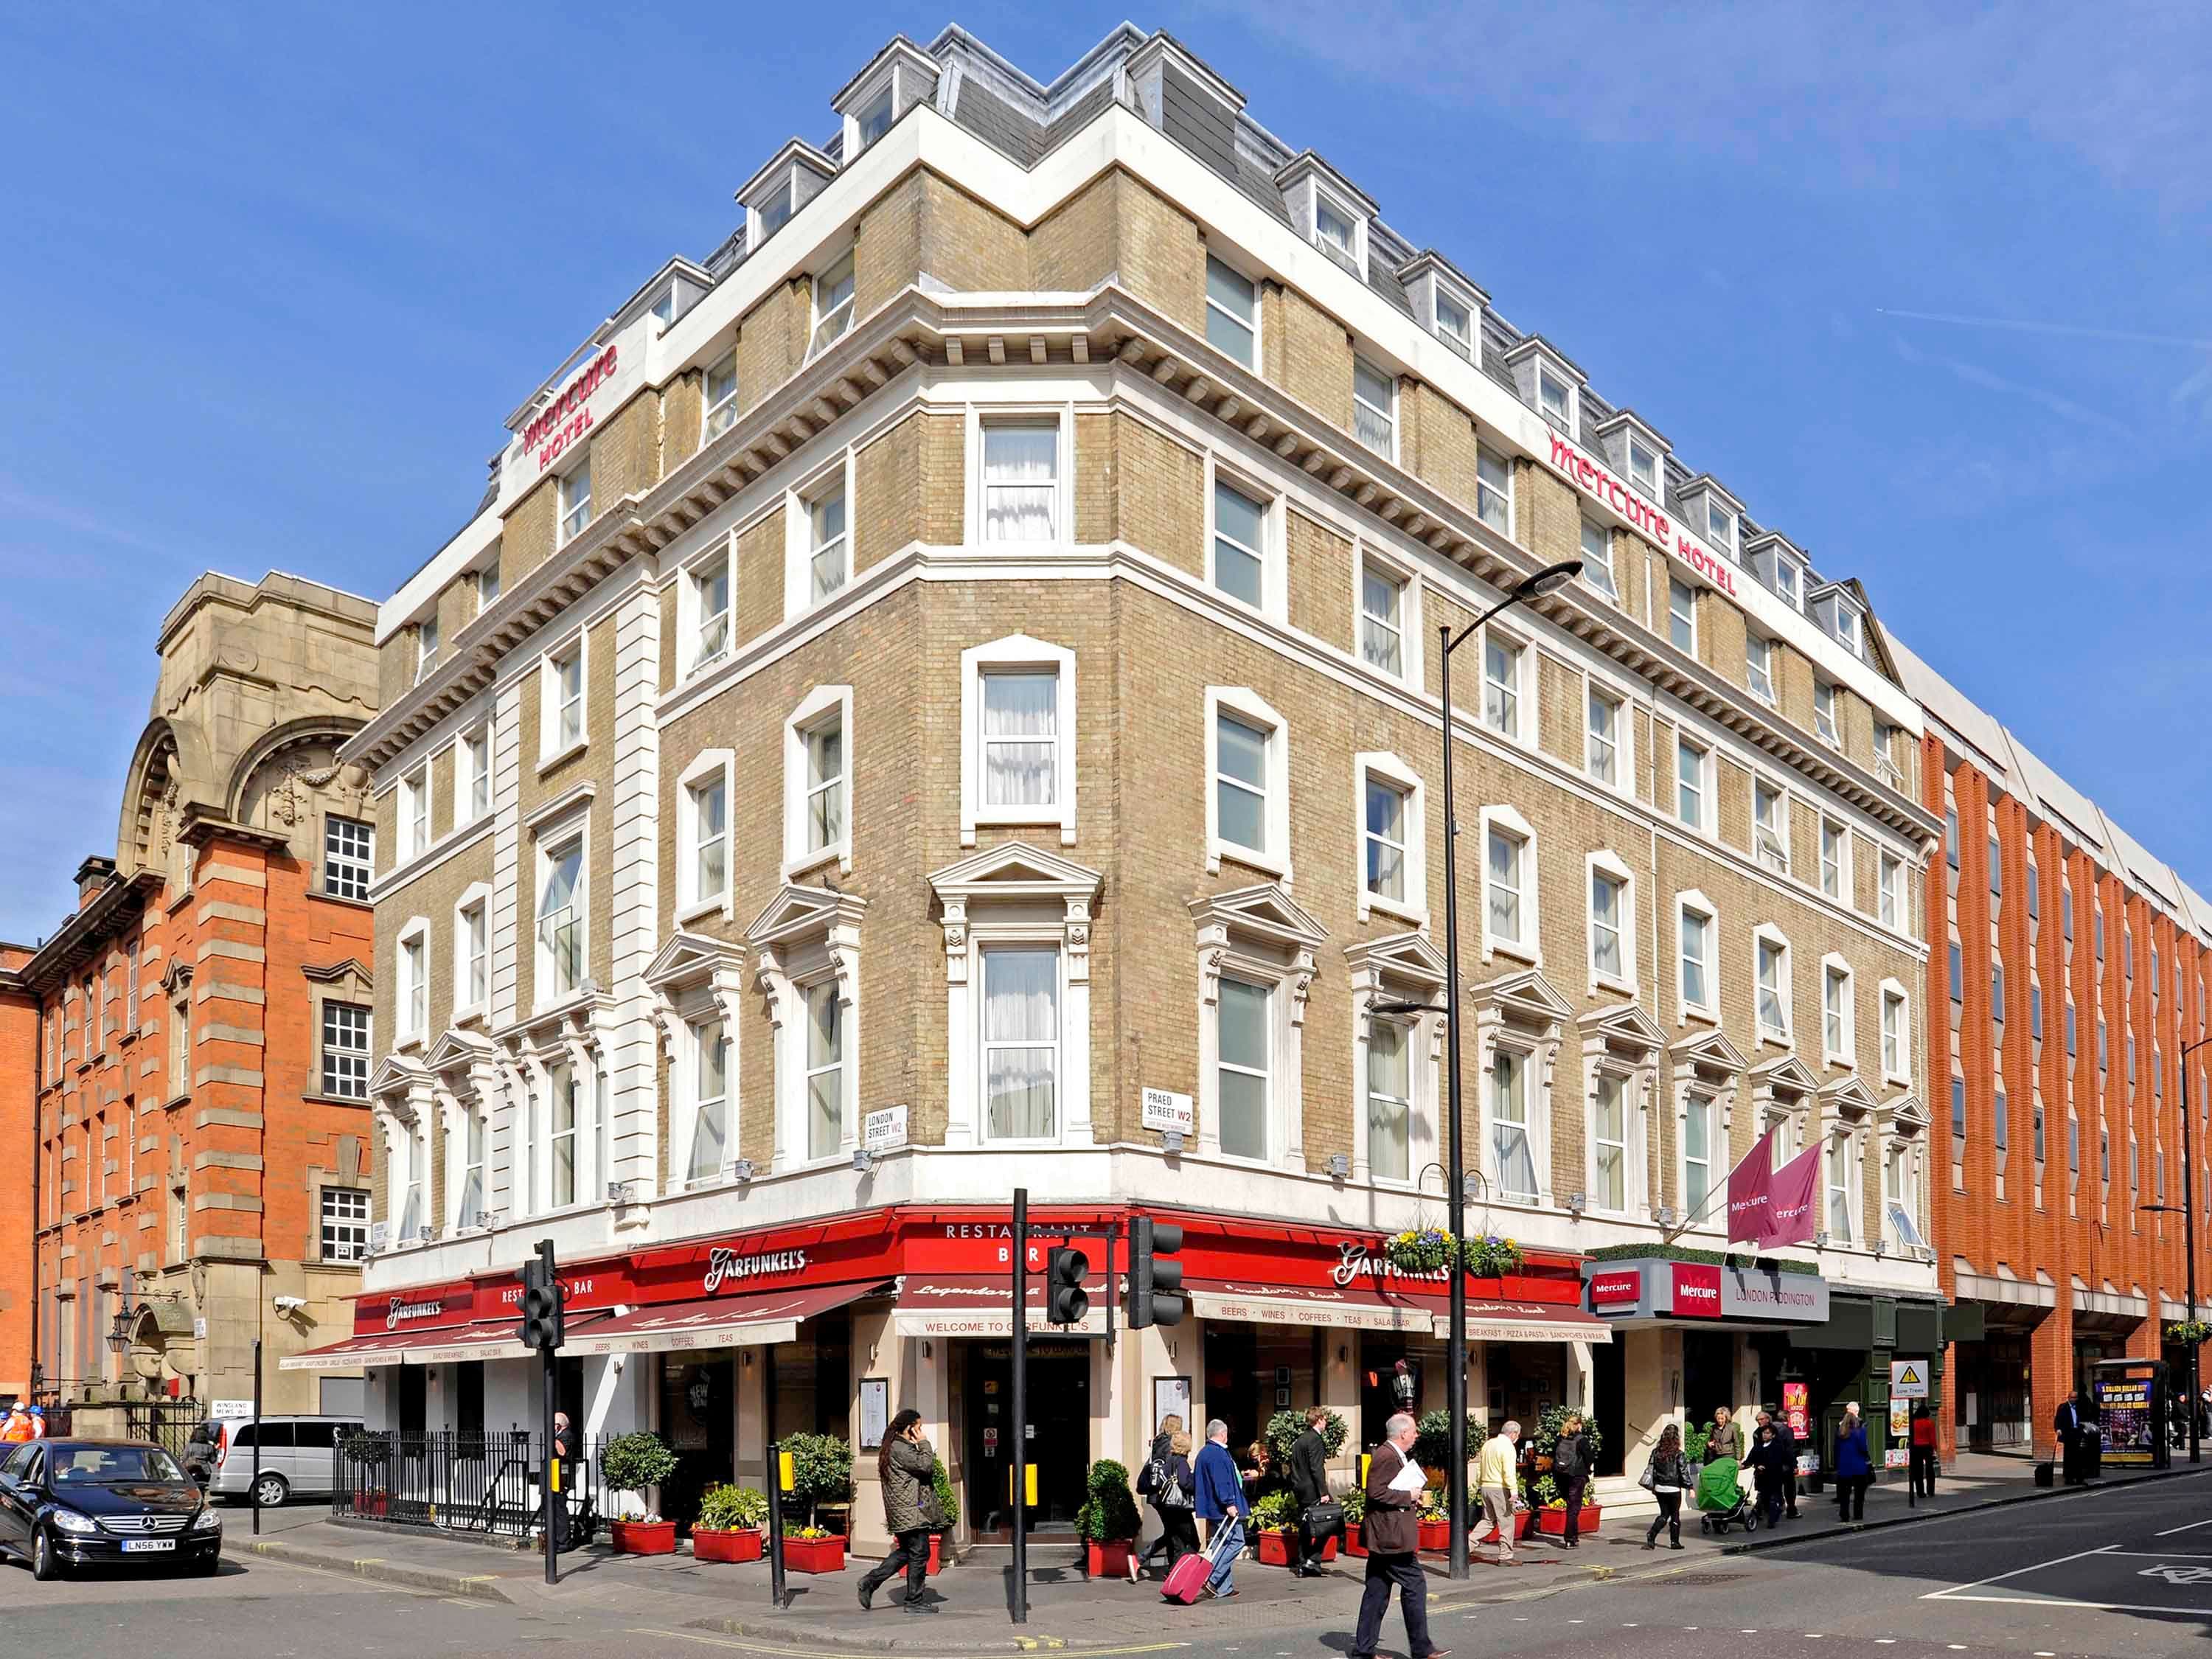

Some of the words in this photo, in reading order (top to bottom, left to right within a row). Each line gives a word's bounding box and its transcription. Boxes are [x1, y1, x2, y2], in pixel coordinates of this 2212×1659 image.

[540, 407, 594, 472] HOTEL
[1677, 535, 1736, 597] HOTEL
[1147, 1092, 1172, 1106] PRAED
[869, 1112, 893, 1127] LONDON
[1147, 1105, 1175, 1119] STREET
[1178, 1110, 1191, 1121] W2
[869, 1124, 889, 1138] STREET
[891, 1121, 902, 1133] W2
[946, 1225, 1090, 1239] RESTARANT
[998, 1248, 1038, 1262] BR
[574, 1280, 593, 1295] BAR
[1596, 1282, 1632, 1293] Mercure
[1680, 1284, 1717, 1299] Mercure
[1736, 1288, 1768, 1302] LONDON
[1770, 1291, 1815, 1307] PADDINGTON
[1220, 1306, 1248, 1317] BEERS
[1262, 1310, 1286, 1320] WINES
[1298, 1312, 1332, 1323] COFFEES
[1343, 1315, 1363, 1325] TEAS
[1373, 1317, 1397, 1327] SALAD
[1397, 1318, 1411, 1328] BAR
[925, 1322, 984, 1332] WELCOME
[989, 1322, 1004, 1332] TO
[631, 1340, 649, 1350] WINES
[672, 1336, 695, 1347] COFFEES
[718, 1333, 734, 1343] TEAS
[1468, 1329, 1501, 1338] BREAKFAST
[1506, 1330, 1523, 1338] PIZZA
[1551, 1332, 1583, 1340] SANDWICHES
[1587, 1333, 1606, 1341] WRAPS
[128, 1541, 154, 1550] LN56
